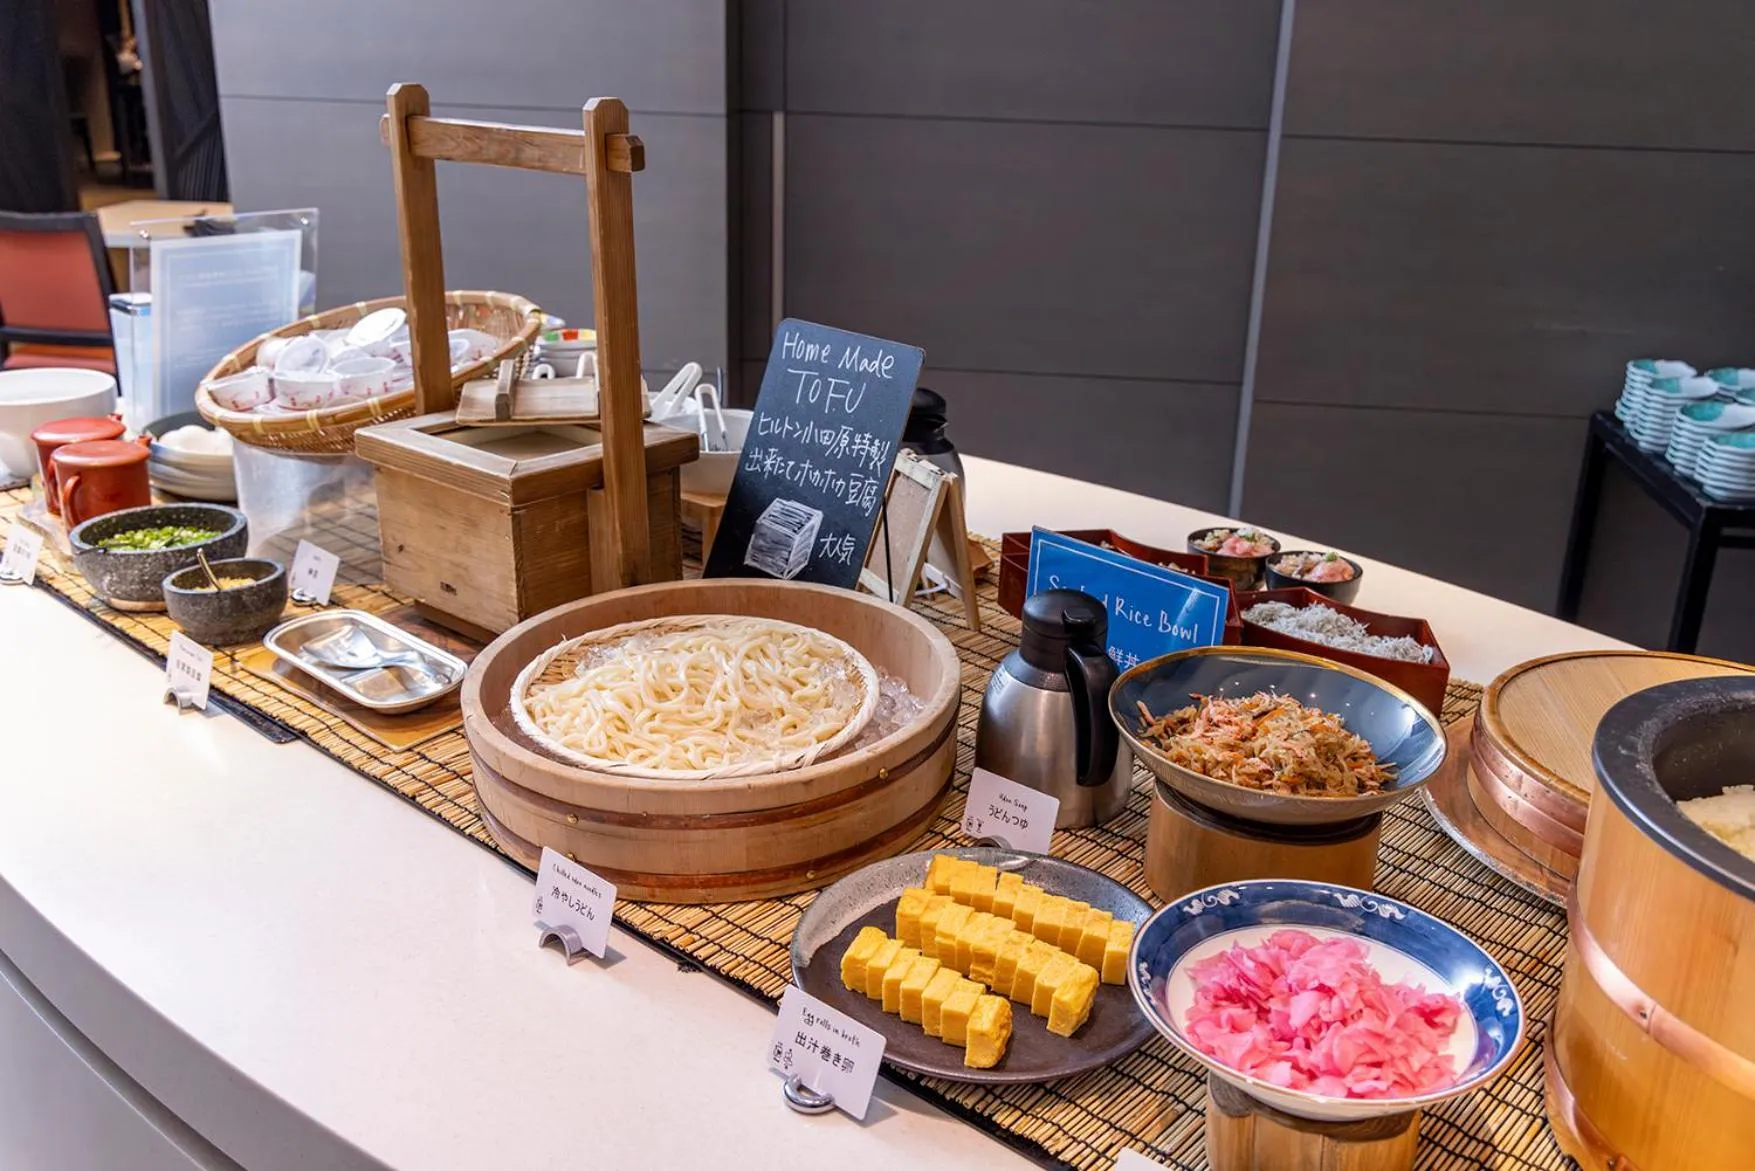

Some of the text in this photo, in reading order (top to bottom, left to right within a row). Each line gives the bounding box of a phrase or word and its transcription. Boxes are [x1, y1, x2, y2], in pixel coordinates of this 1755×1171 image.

[782, 331, 895, 379] Home Made
[787, 368, 867, 414] TOFU
[758, 411, 891, 478] ヒルトン小田原特製
[745, 447, 880, 518] 出来たてホカホカ豆腐
[818, 533, 856, 566] 大人気
[1114, 596, 1199, 644] Rice Bowl
[1108, 645, 1141, 669] 鮮丼
[988, 803, 1029, 830] うどんつゆ
[551, 885, 595, 921] 冷やしうどん
[802, 1007, 814, 1027] Egg
[794, 1030, 855, 1074] 出汁巻き卵
